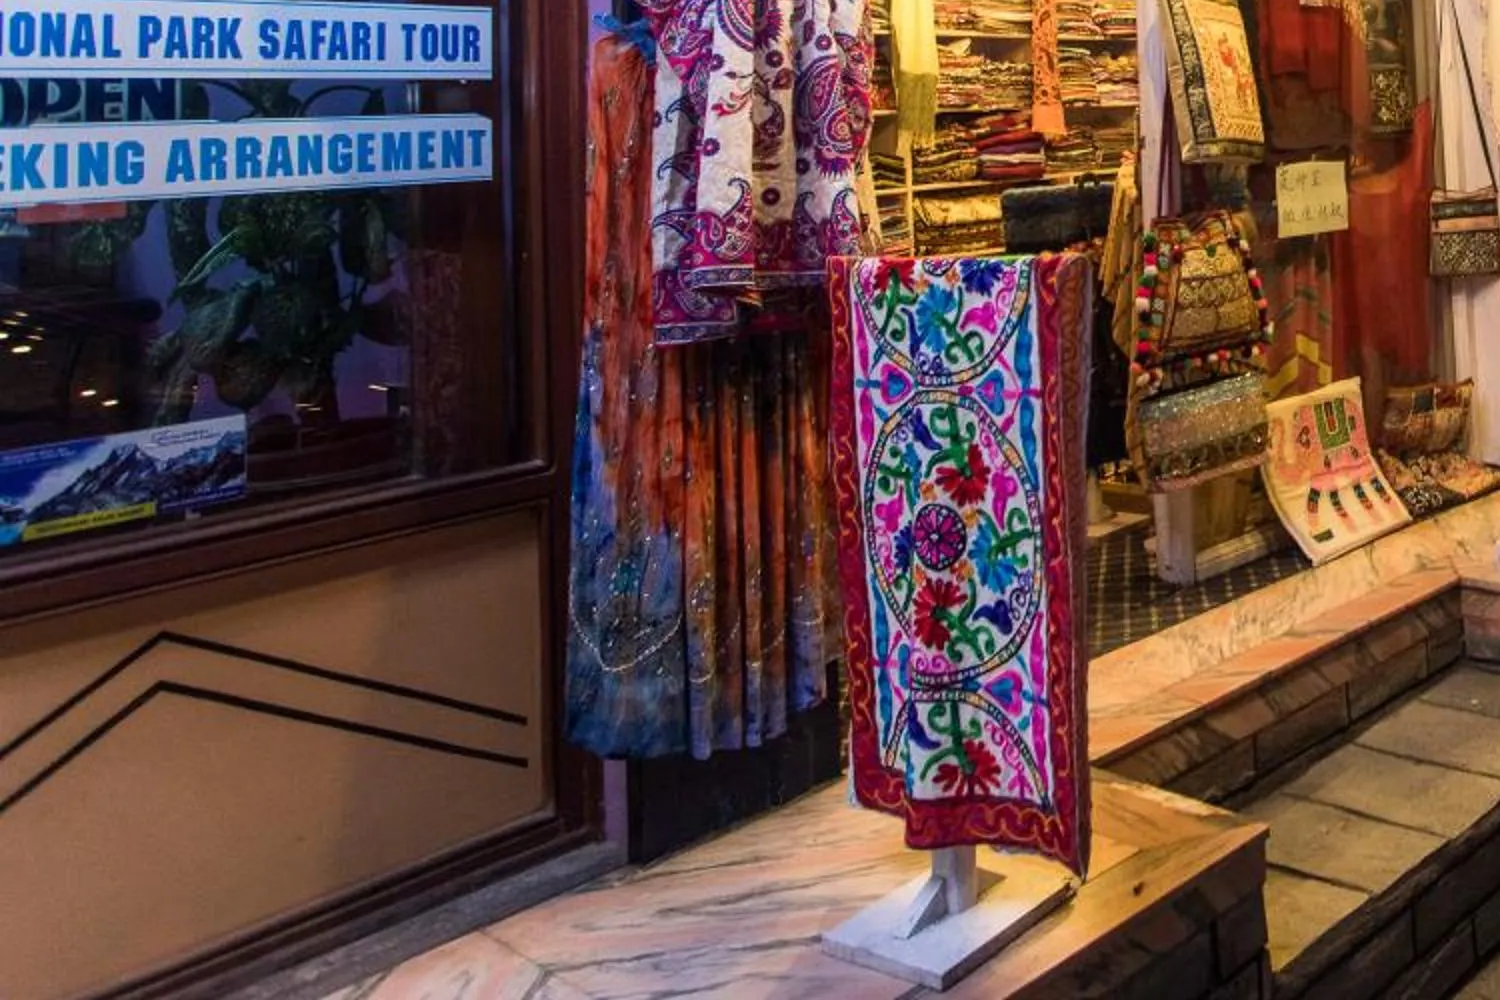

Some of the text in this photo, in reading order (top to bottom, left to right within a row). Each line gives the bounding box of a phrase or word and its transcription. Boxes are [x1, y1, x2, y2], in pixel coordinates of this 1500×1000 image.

[138, 14, 243, 60] PARK
[259, 17, 387, 62] SAFARI
[402, 22, 481, 63] TOUR
[0, 128, 486, 191] KING ARRANGEMENT
